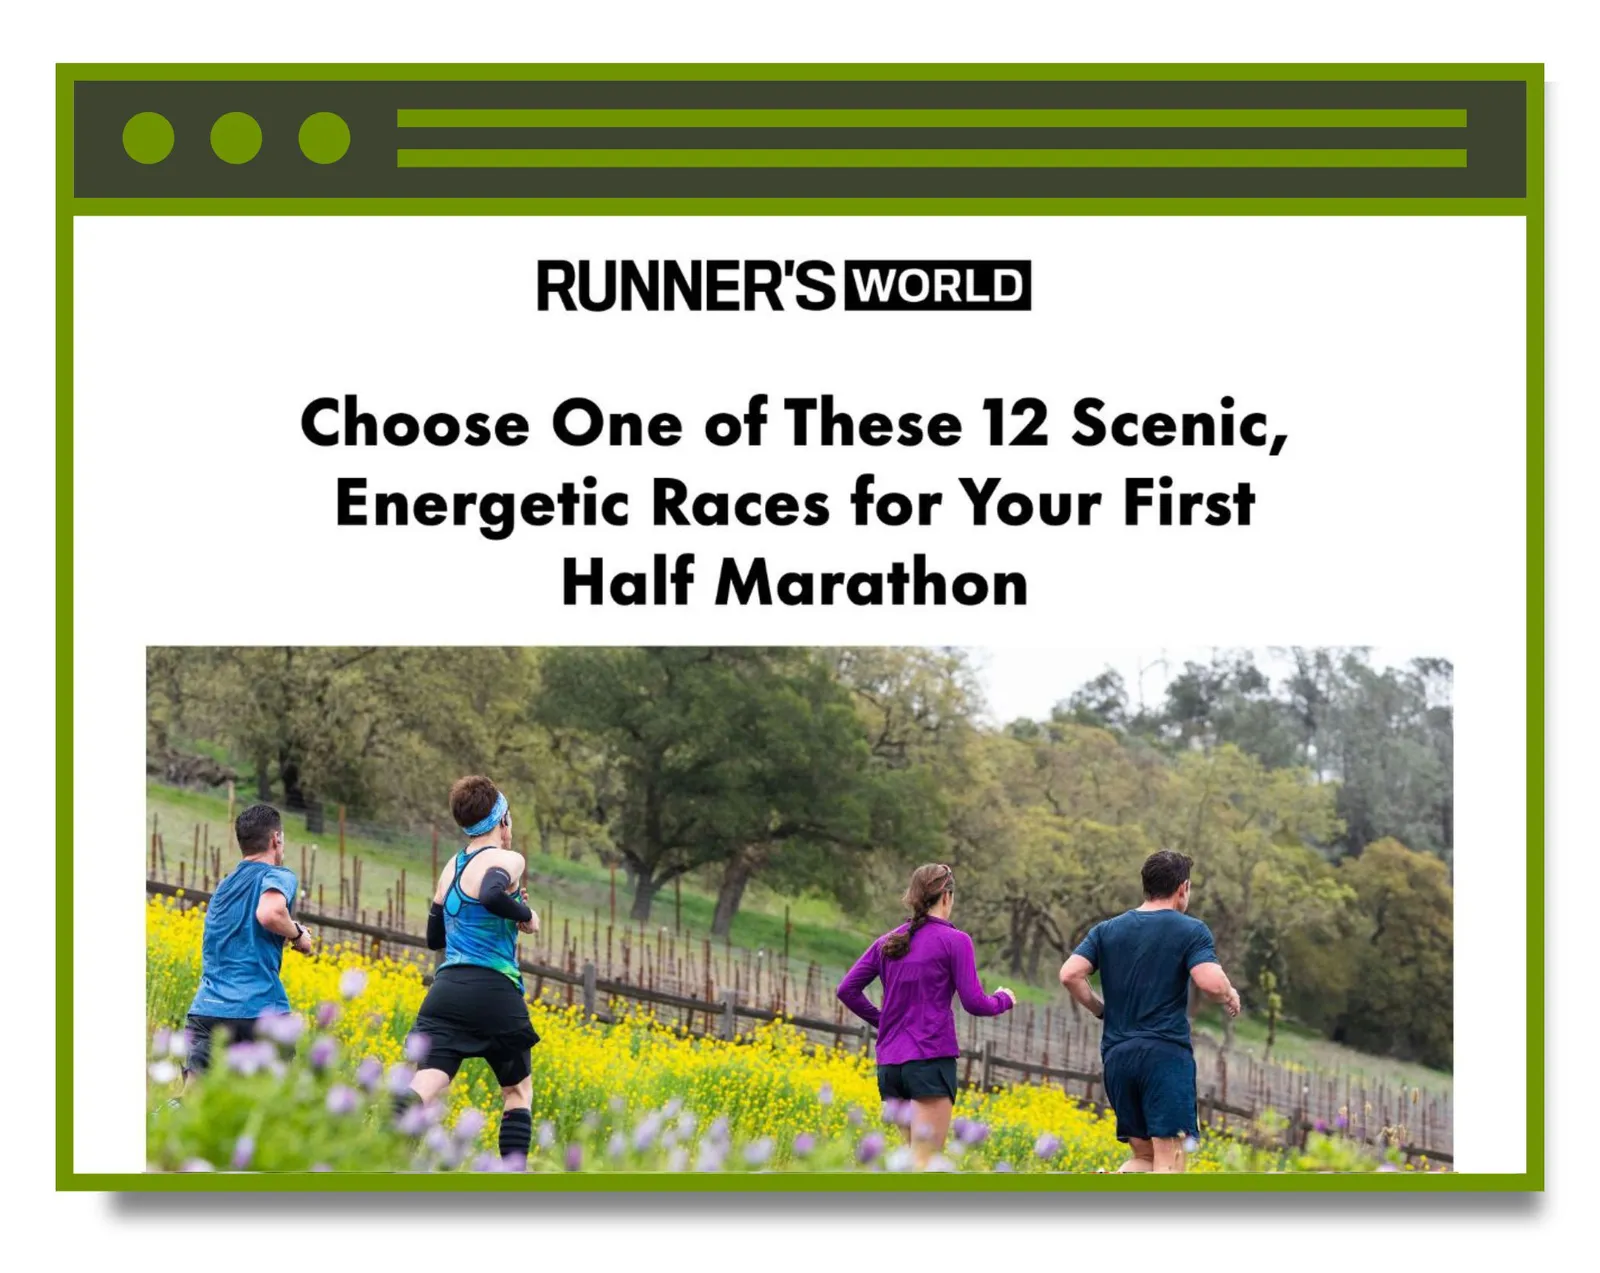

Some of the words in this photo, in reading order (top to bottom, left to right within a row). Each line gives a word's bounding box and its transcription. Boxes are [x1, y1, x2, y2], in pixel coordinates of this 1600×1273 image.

[537, 259, 837, 312] RUNNER'S
[852, 268, 1024, 303] WORLD
[301, 394, 530, 447] Choose
[552, 397, 683, 447] One
[705, 393, 769, 447] of
[783, 394, 962, 447] These
[982, 397, 1048, 446] 12
[1071, 395, 1288, 456] Scenic,
[337, 475, 629, 541] Energetic
[653, 477, 830, 527] Races
[850, 473, 943, 527] for
[957, 477, 1103, 527] Your
[1125, 475, 1256, 527] First
[563, 552, 695, 606] Half
[714, 553, 1027, 606] Marathon
